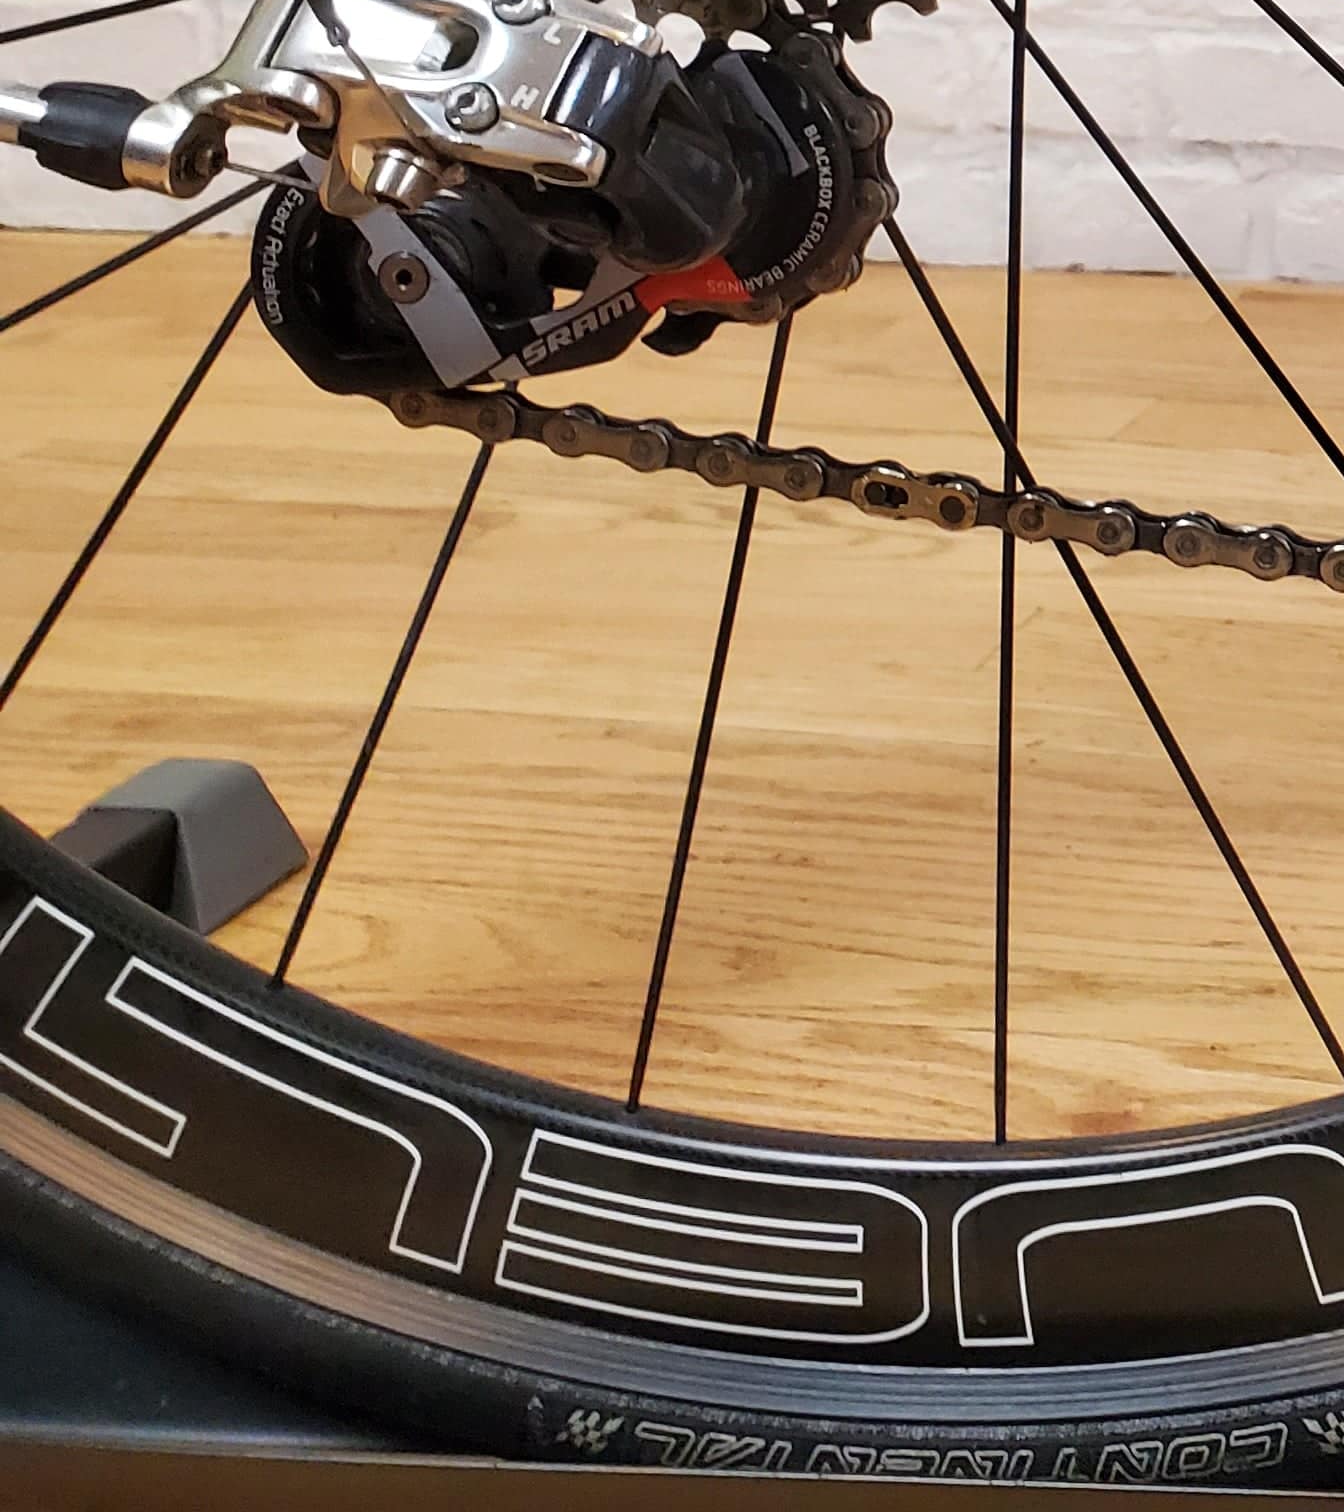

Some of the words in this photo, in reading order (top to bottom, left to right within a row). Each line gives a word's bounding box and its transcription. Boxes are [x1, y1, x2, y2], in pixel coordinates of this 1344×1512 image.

[543, 22, 562, 46] L
[510, 83, 541, 111] H
[803, 123, 834, 211] BLACKBOX
[782, 210, 829, 273] CERAMIC
[706, 268, 785, 295] BEARINGS
[522, 290, 637, 367] SRAM
